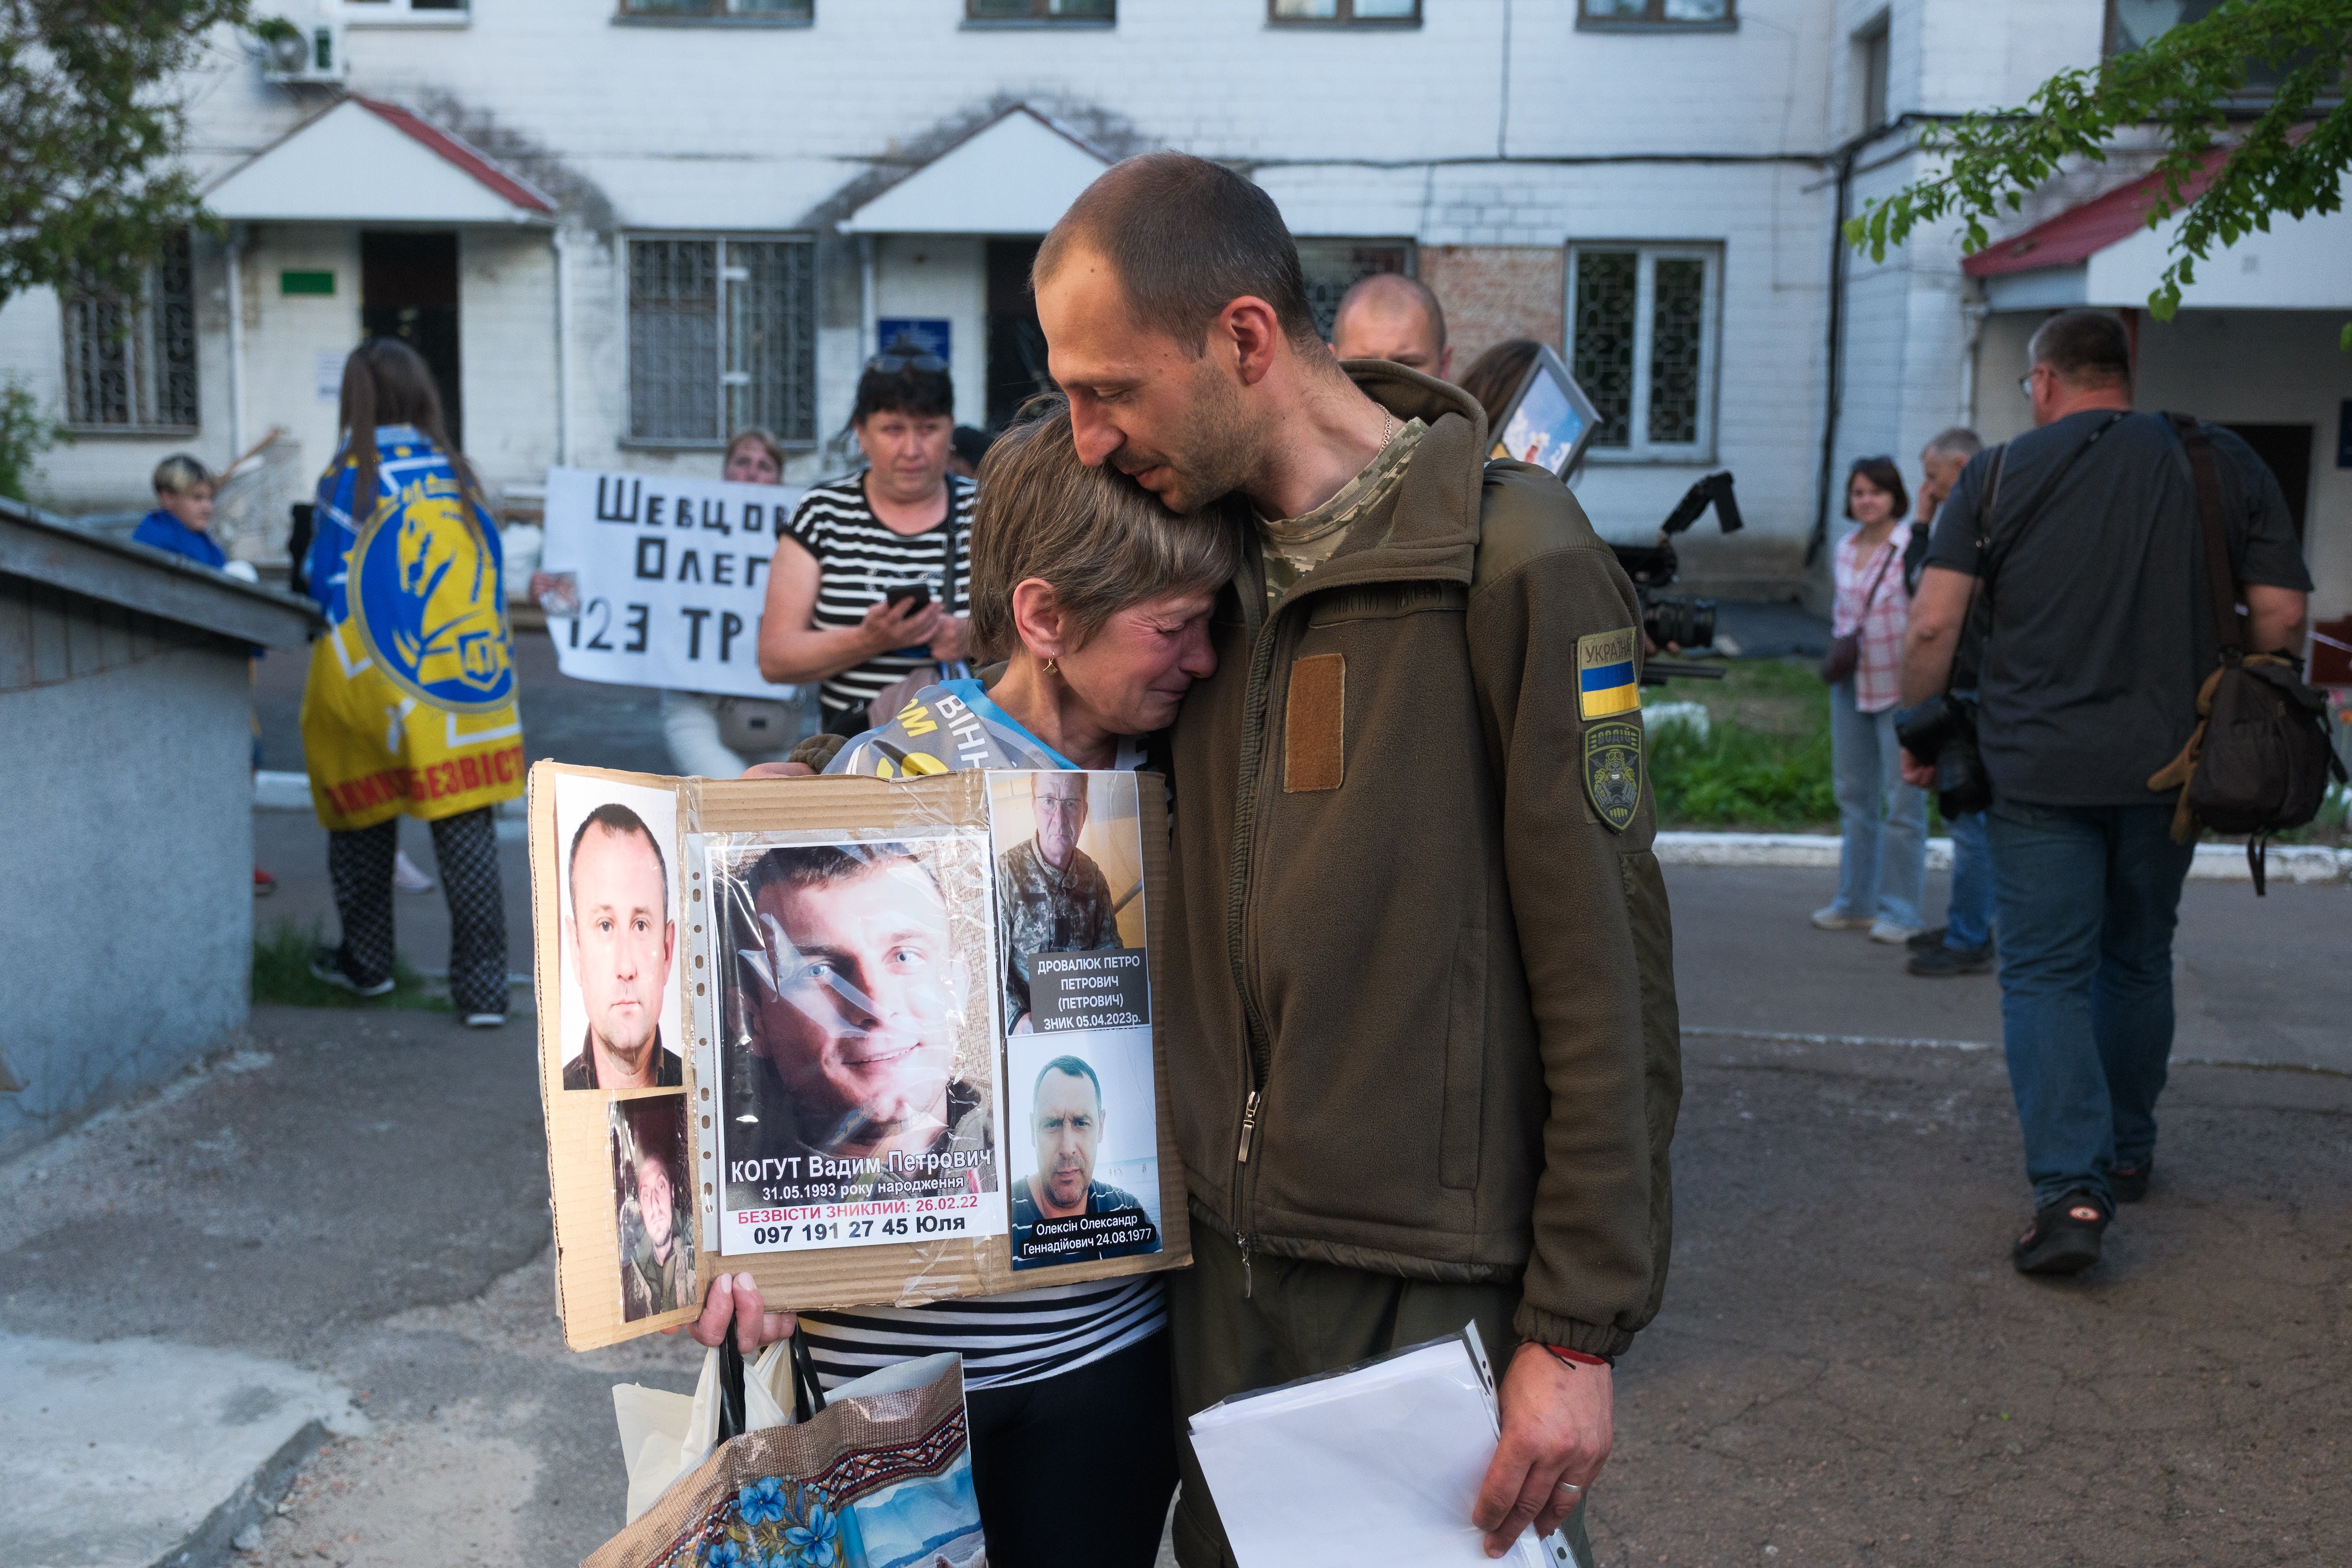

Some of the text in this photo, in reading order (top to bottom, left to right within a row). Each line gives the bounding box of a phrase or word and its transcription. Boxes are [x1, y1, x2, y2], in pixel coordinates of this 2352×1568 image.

[681, 607, 763, 663] ТР
[1597, 727, 1631, 745] ВОДІЙ
[1037, 955, 1140, 975] ДРОВАЛЮК ПЕТРО
[1061, 975, 1119, 991] ПЕТРОВИЧ
[1058, 993, 1124, 1012] (ПЕТРОВИЧ)
[1044, 1012, 1141, 1030] ЗНИК 05.04.2023р.
[731, 1149, 992, 1183] КОГУТ Вадим Петрович
[763, 1176, 964, 1201] 31.05.1993 року народження
[738, 1195, 978, 1225] БЕЗВІСТИ ЗНИКЛИЙ: 26.02.22
[754, 1215, 965, 1245] 097 191 27 45 Юля
[1036, 1215, 1138, 1236] Олексін Олександр
[1023, 1228, 1152, 1255] Геннадійович 24.08.1977
